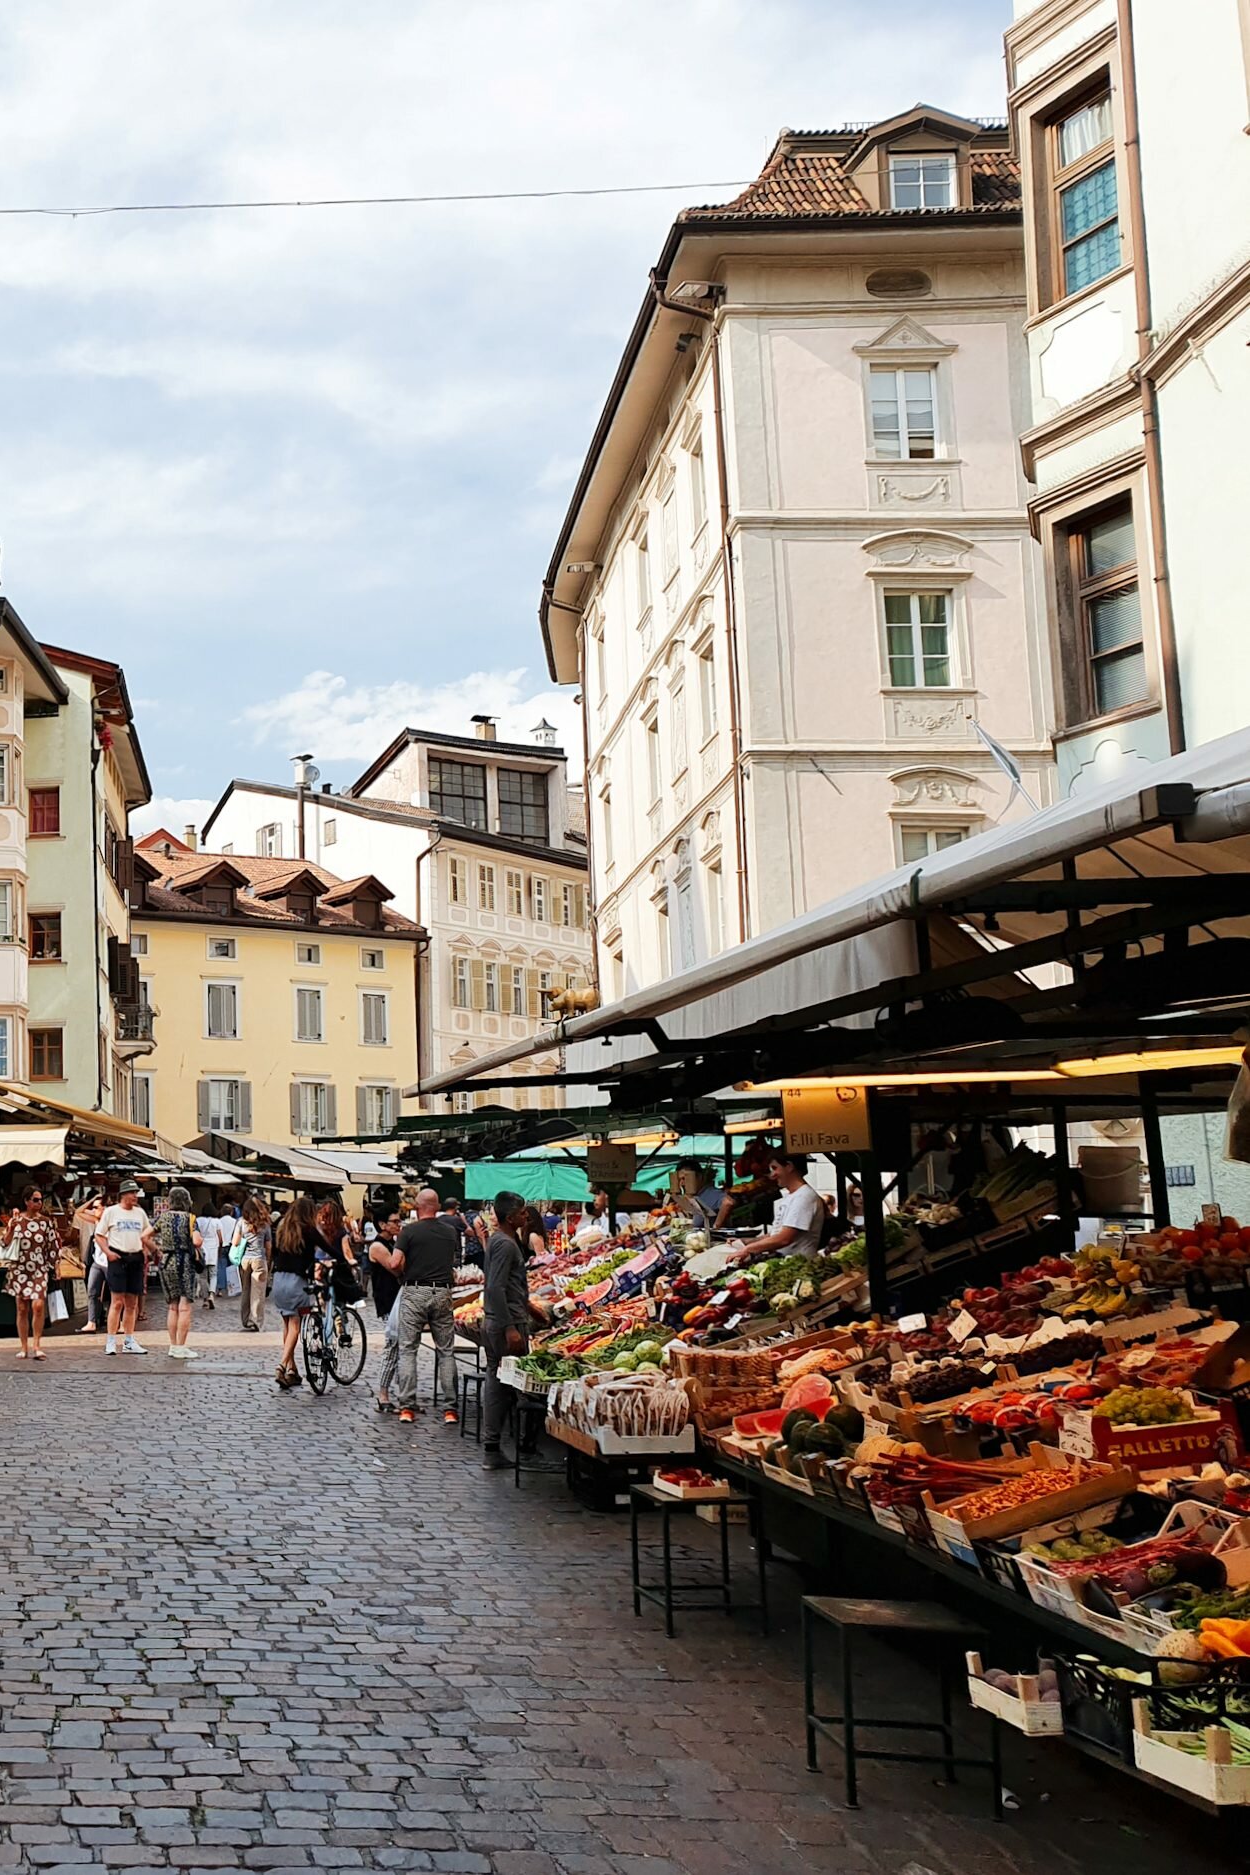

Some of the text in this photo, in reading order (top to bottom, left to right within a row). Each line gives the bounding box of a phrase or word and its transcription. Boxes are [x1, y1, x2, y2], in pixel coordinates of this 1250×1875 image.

[787, 1088, 801, 1097] 44
[790, 1133, 850, 1147] F.lli Fava
